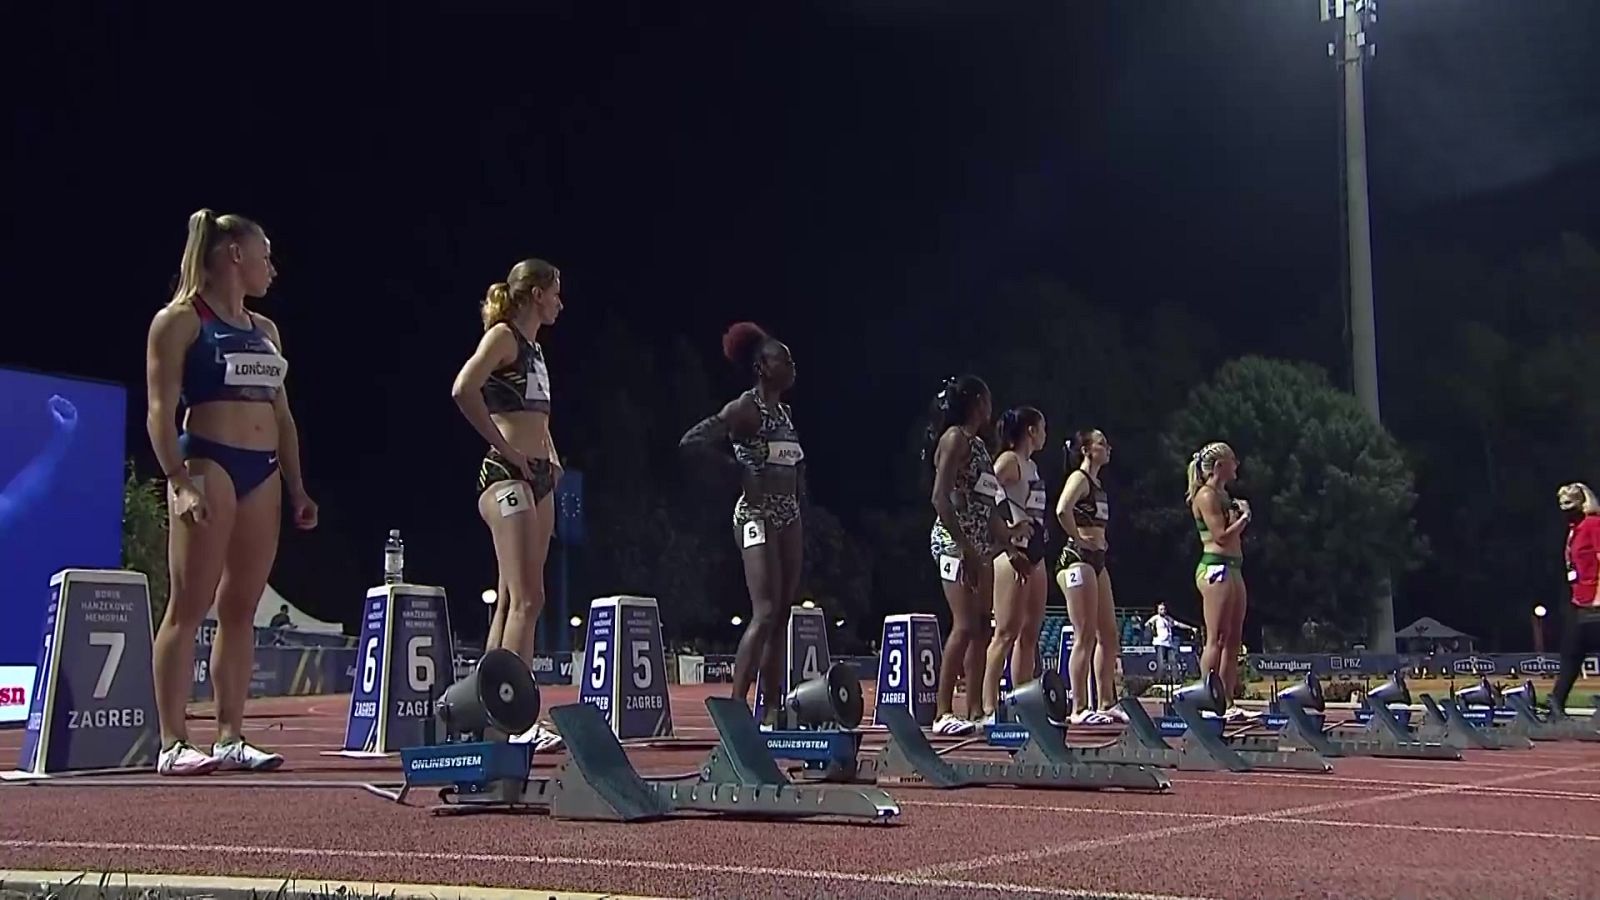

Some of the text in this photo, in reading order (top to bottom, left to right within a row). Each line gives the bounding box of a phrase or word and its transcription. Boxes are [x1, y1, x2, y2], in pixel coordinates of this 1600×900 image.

[507, 491, 519, 507] 6
[748, 526, 757, 538] 5
[943, 562, 952, 574] 4
[1069, 573, 1077, 583] 2
[85, 613, 128, 622] MEMORIAL
[89, 632, 125, 699] 7
[363, 637, 378, 693] 6
[407, 636, 435, 691] 6
[591, 641, 607, 689] 5
[631, 640, 652, 688] 5
[803, 645, 821, 679] 4
[888, 649, 902, 687] 3
[921, 649, 936, 687] 3
[626, 696, 662, 709] ZAGREB
[881, 692, 906, 703] ZAGREB
[918, 693, 938, 703] ZAGR
[354, 701, 377, 717] ZAGREB
[68, 709, 144, 728] ZAGREB
